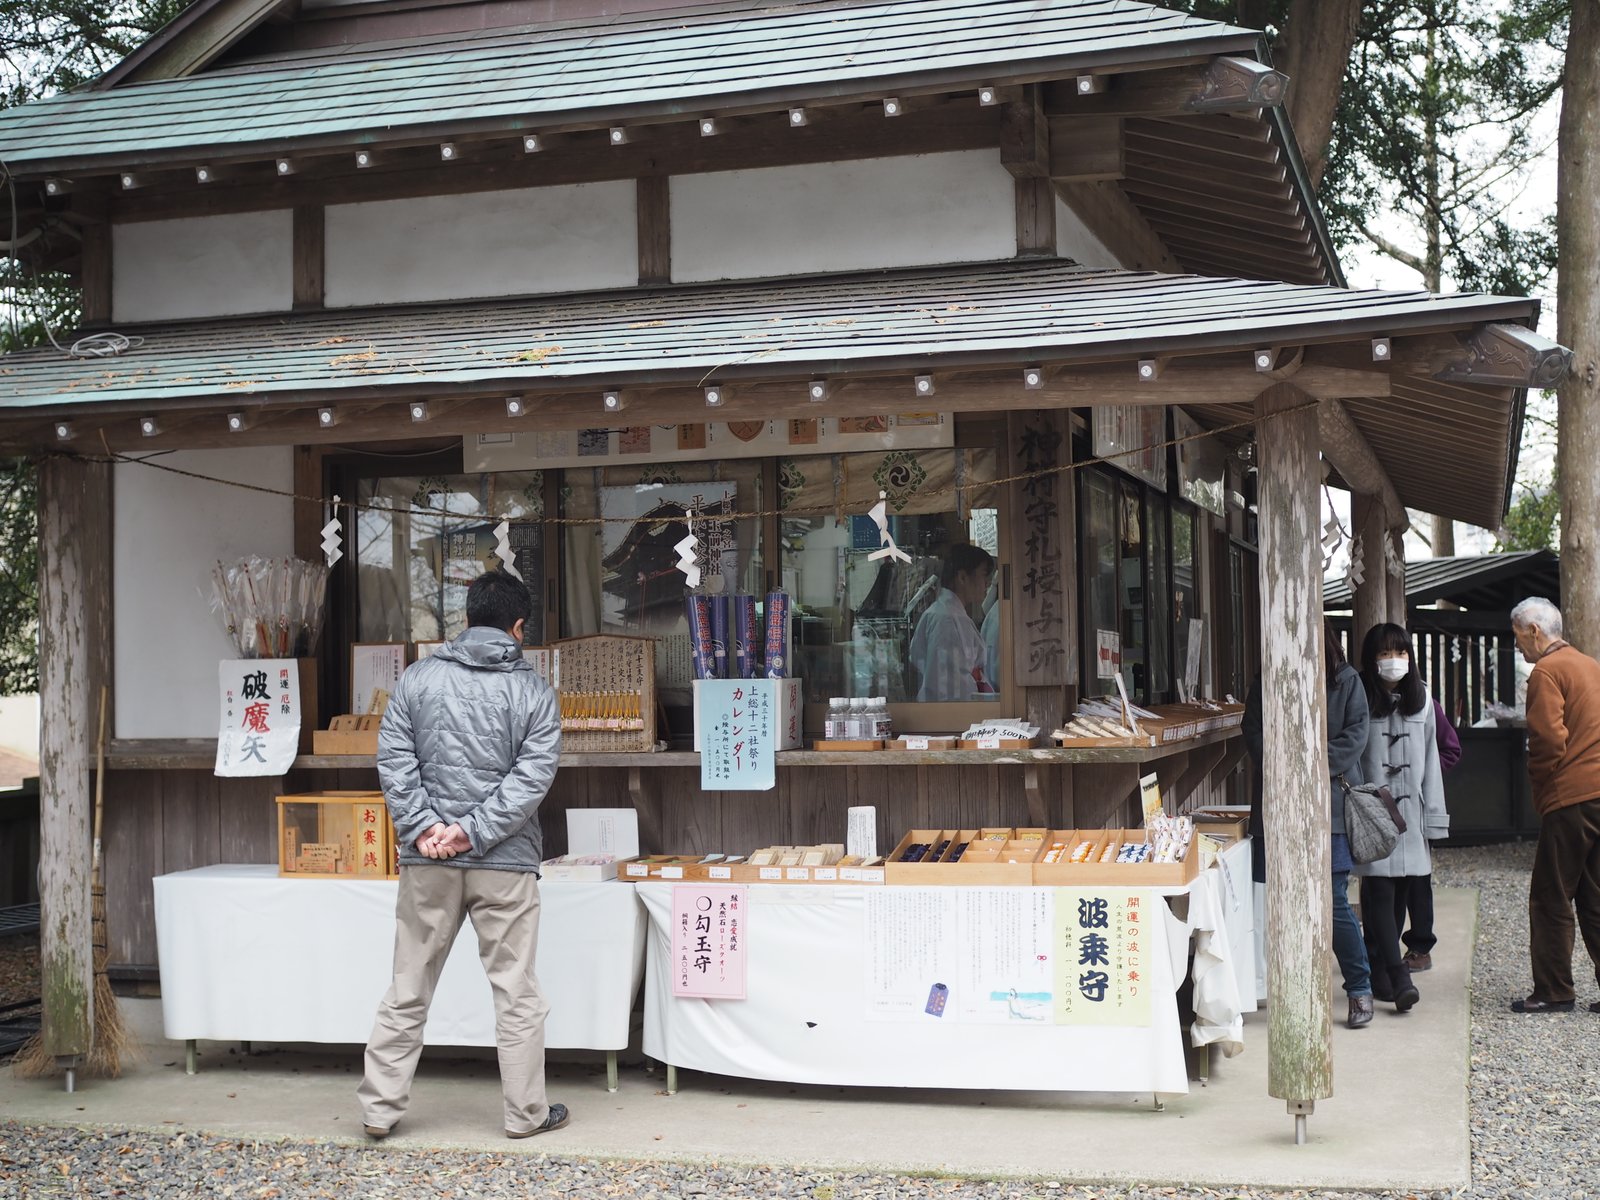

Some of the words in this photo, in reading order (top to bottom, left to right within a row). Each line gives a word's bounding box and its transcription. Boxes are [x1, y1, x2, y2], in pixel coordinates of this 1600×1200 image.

[708, 519, 722, 576] 玉前神社
[1017, 424, 1065, 673] 神符守札授与所
[240, 670, 271, 763] 破魔矢
[281, 694, 290, 714] 厄除
[732, 687, 745, 771] カレンダー
[748, 686, 759, 771] 上総十二社祭り
[363, 809, 377, 867] お賽銭
[730, 919, 738, 951] 恋愛成就
[1078, 897, 1109, 1002] 波乗守
[1126, 897, 1140, 997] 開運の波に乗り
